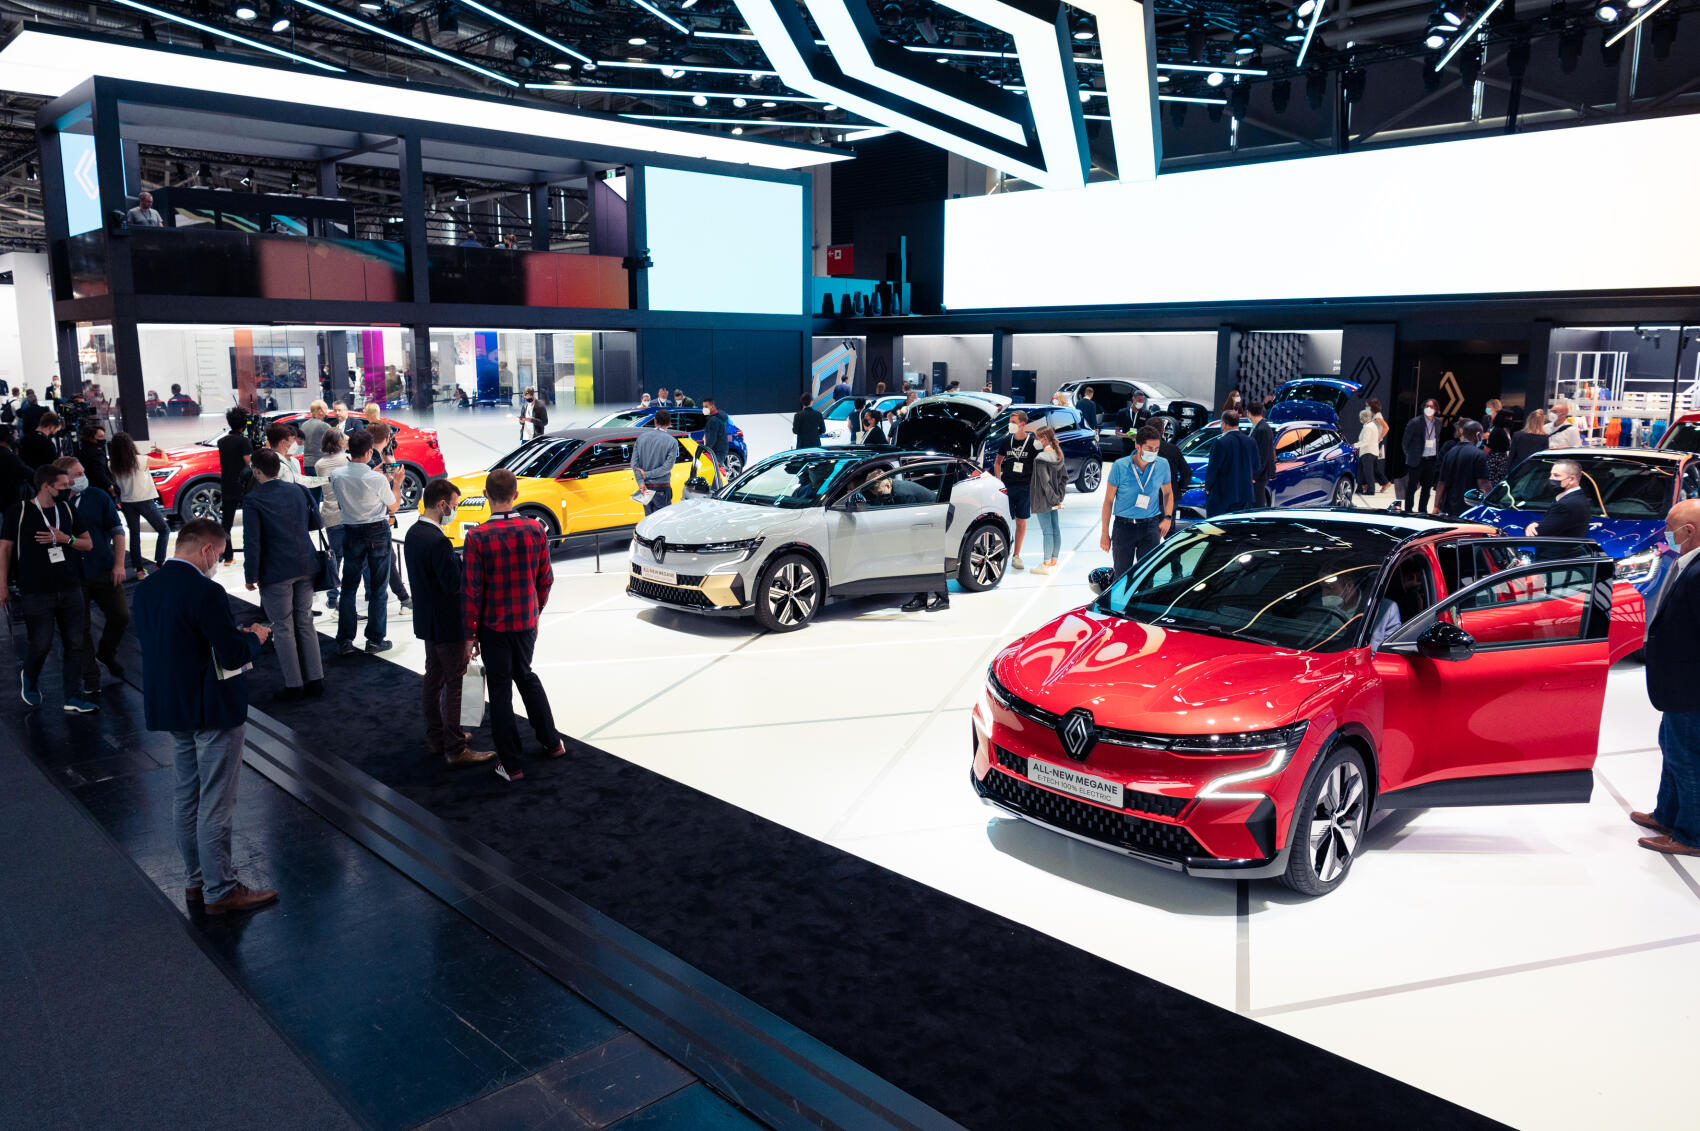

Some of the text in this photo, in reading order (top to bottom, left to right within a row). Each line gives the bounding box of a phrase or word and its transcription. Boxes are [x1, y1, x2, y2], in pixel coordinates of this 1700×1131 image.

[1032, 763, 1118, 795] ALL-NEW MEGANE
[1037, 775, 1112, 801] E-TECH 100% ELECTRIC
